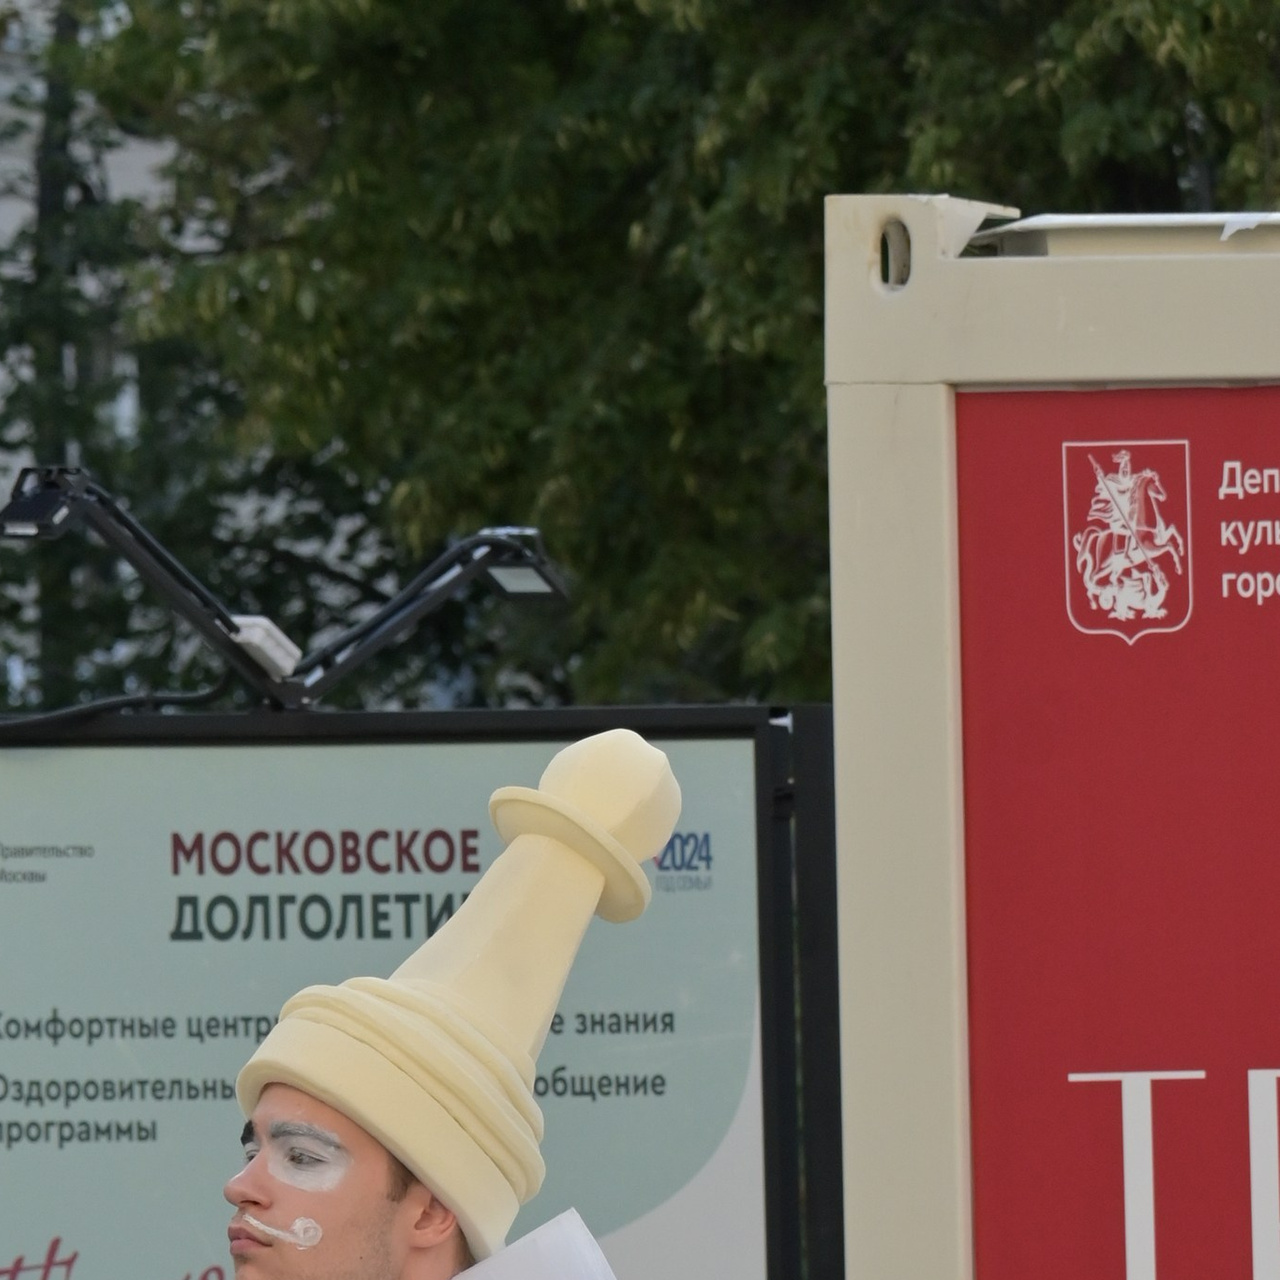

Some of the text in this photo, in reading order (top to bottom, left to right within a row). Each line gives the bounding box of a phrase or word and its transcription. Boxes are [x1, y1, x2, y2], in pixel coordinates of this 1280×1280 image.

[1218, 460, 1280, 500] Деп
[171, 829, 480, 875] МОСКОВСКОЕ
[658, 832, 713, 871] 2024
[170, 893, 469, 941] ДОЛГОЛЕТИ
[186, 1015, 279, 1044] центр
[575, 1011, 675, 1034] знания
[533, 1066, 666, 1101] общение
